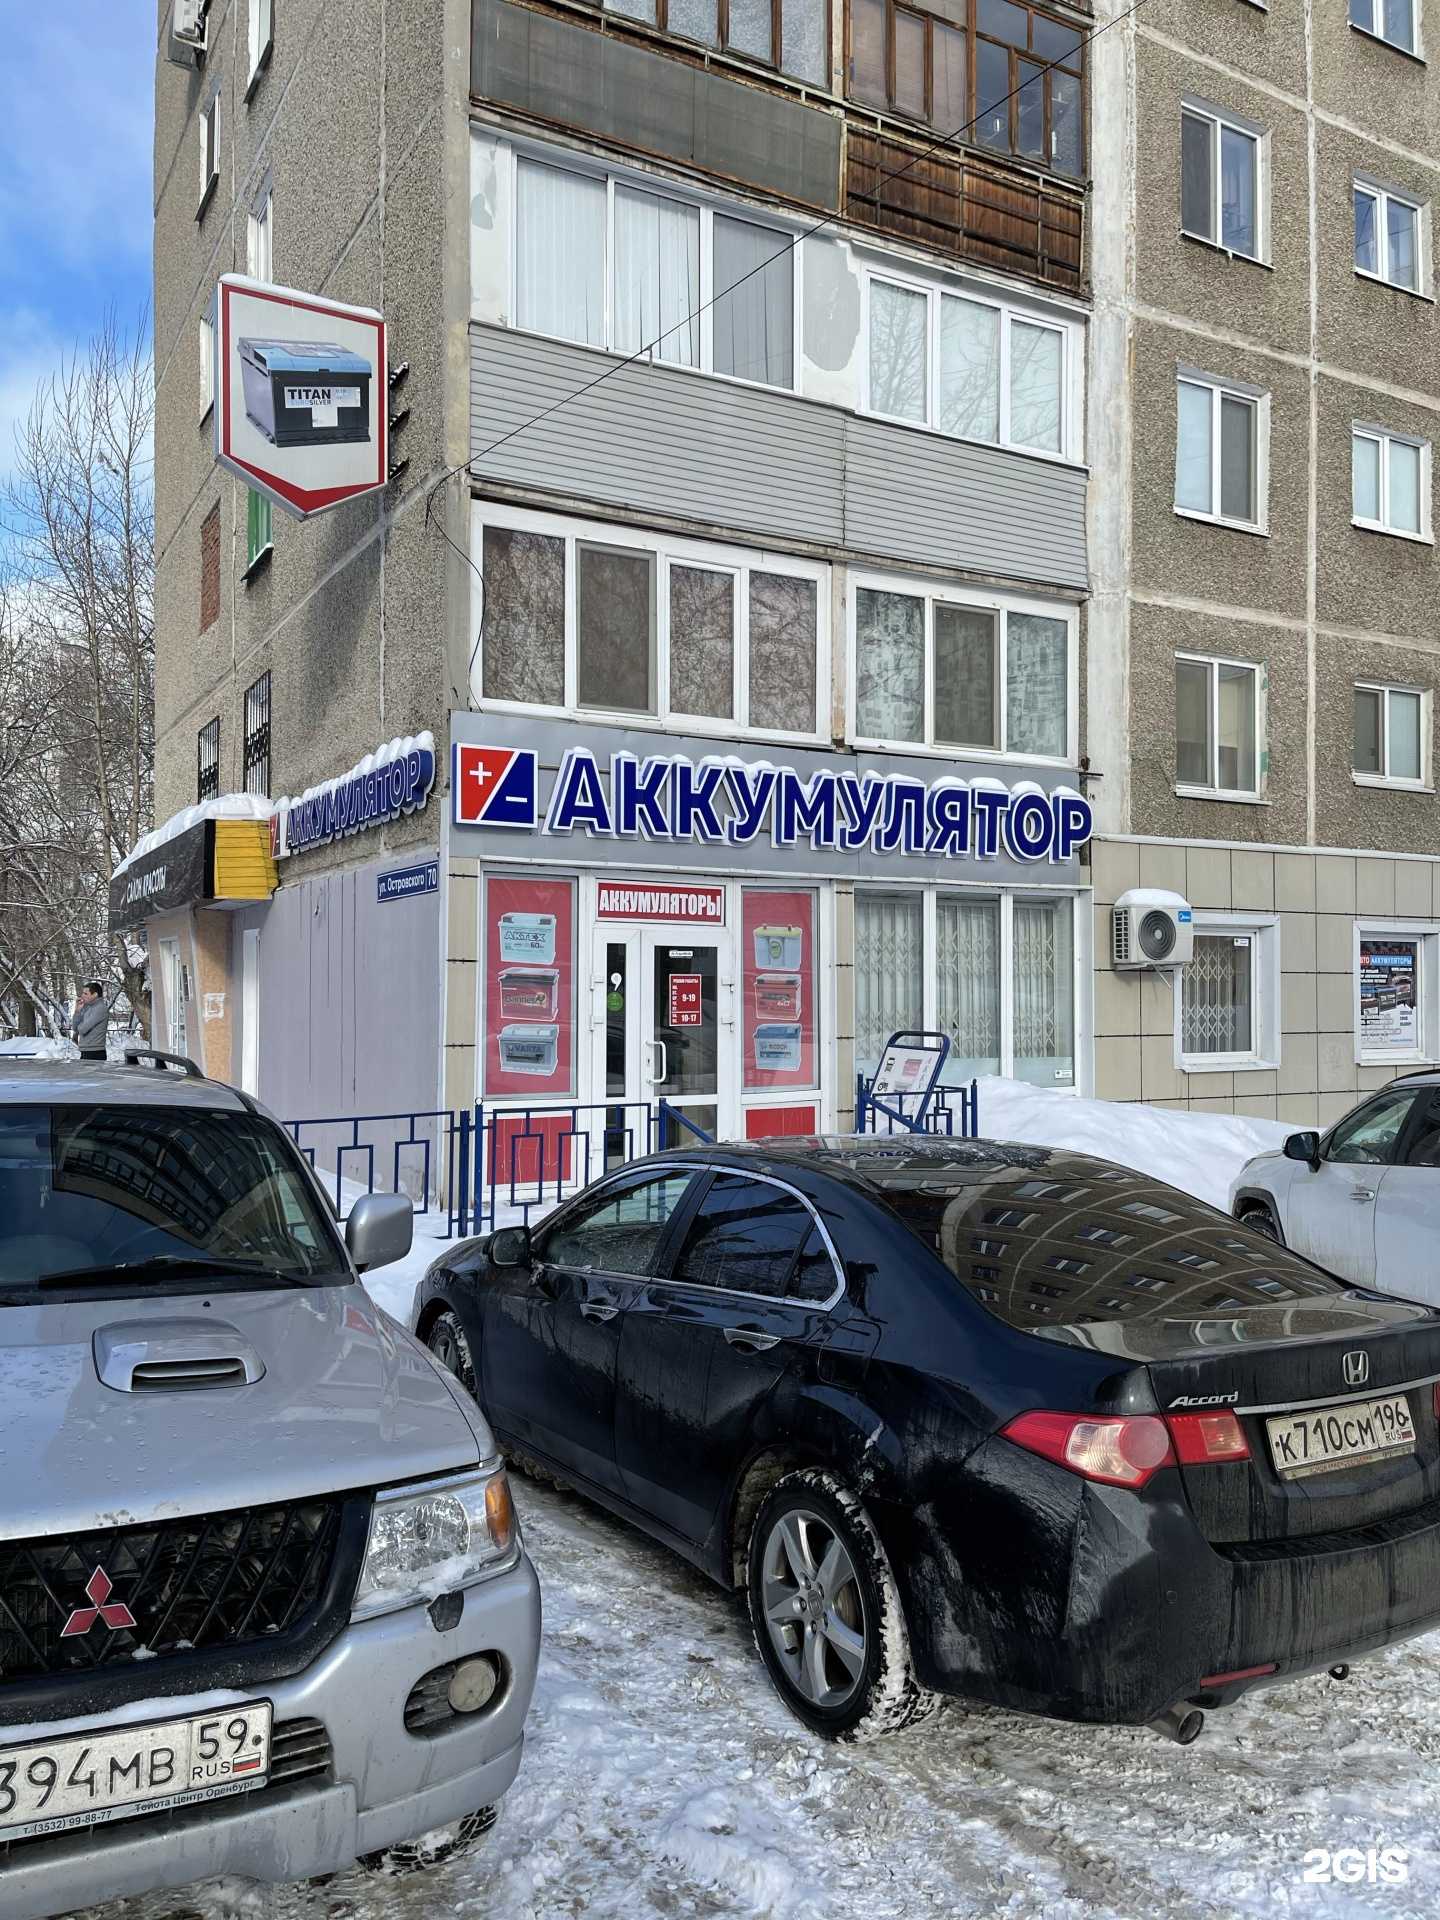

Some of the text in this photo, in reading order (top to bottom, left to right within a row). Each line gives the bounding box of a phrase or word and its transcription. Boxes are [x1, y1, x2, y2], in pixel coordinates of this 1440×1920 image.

[288, 389, 331, 399] TITAN
[287, 749, 428, 848] АККУМУЛЯТОР
[549, 752, 1094, 864] АККУМУЛЯТОР
[127, 877, 142, 904] САЛОН
[387, 875, 425, 893] Островского
[427, 868, 437, 886] 70
[599, 889, 721, 917] АККУМУЛЯТОРЫ
[682, 993, 696, 1002] 9-19
[681, 1014, 697, 1022] 10-17
[1168, 1391, 1239, 1408] Accord
[1385, 1428, 1401, 1441] RUS
[198, 1718, 248, 1760] 59
[192, 1761, 231, 1781] RUS
[34, 1818, 66, 1834] (3532)
[68, 1810, 112, 1827] 99-88-77
[135, 1798, 171, 1813] Тойота
[173, 1791, 203, 1806] Центр
[206, 1780, 255, 1799] Оренбург
